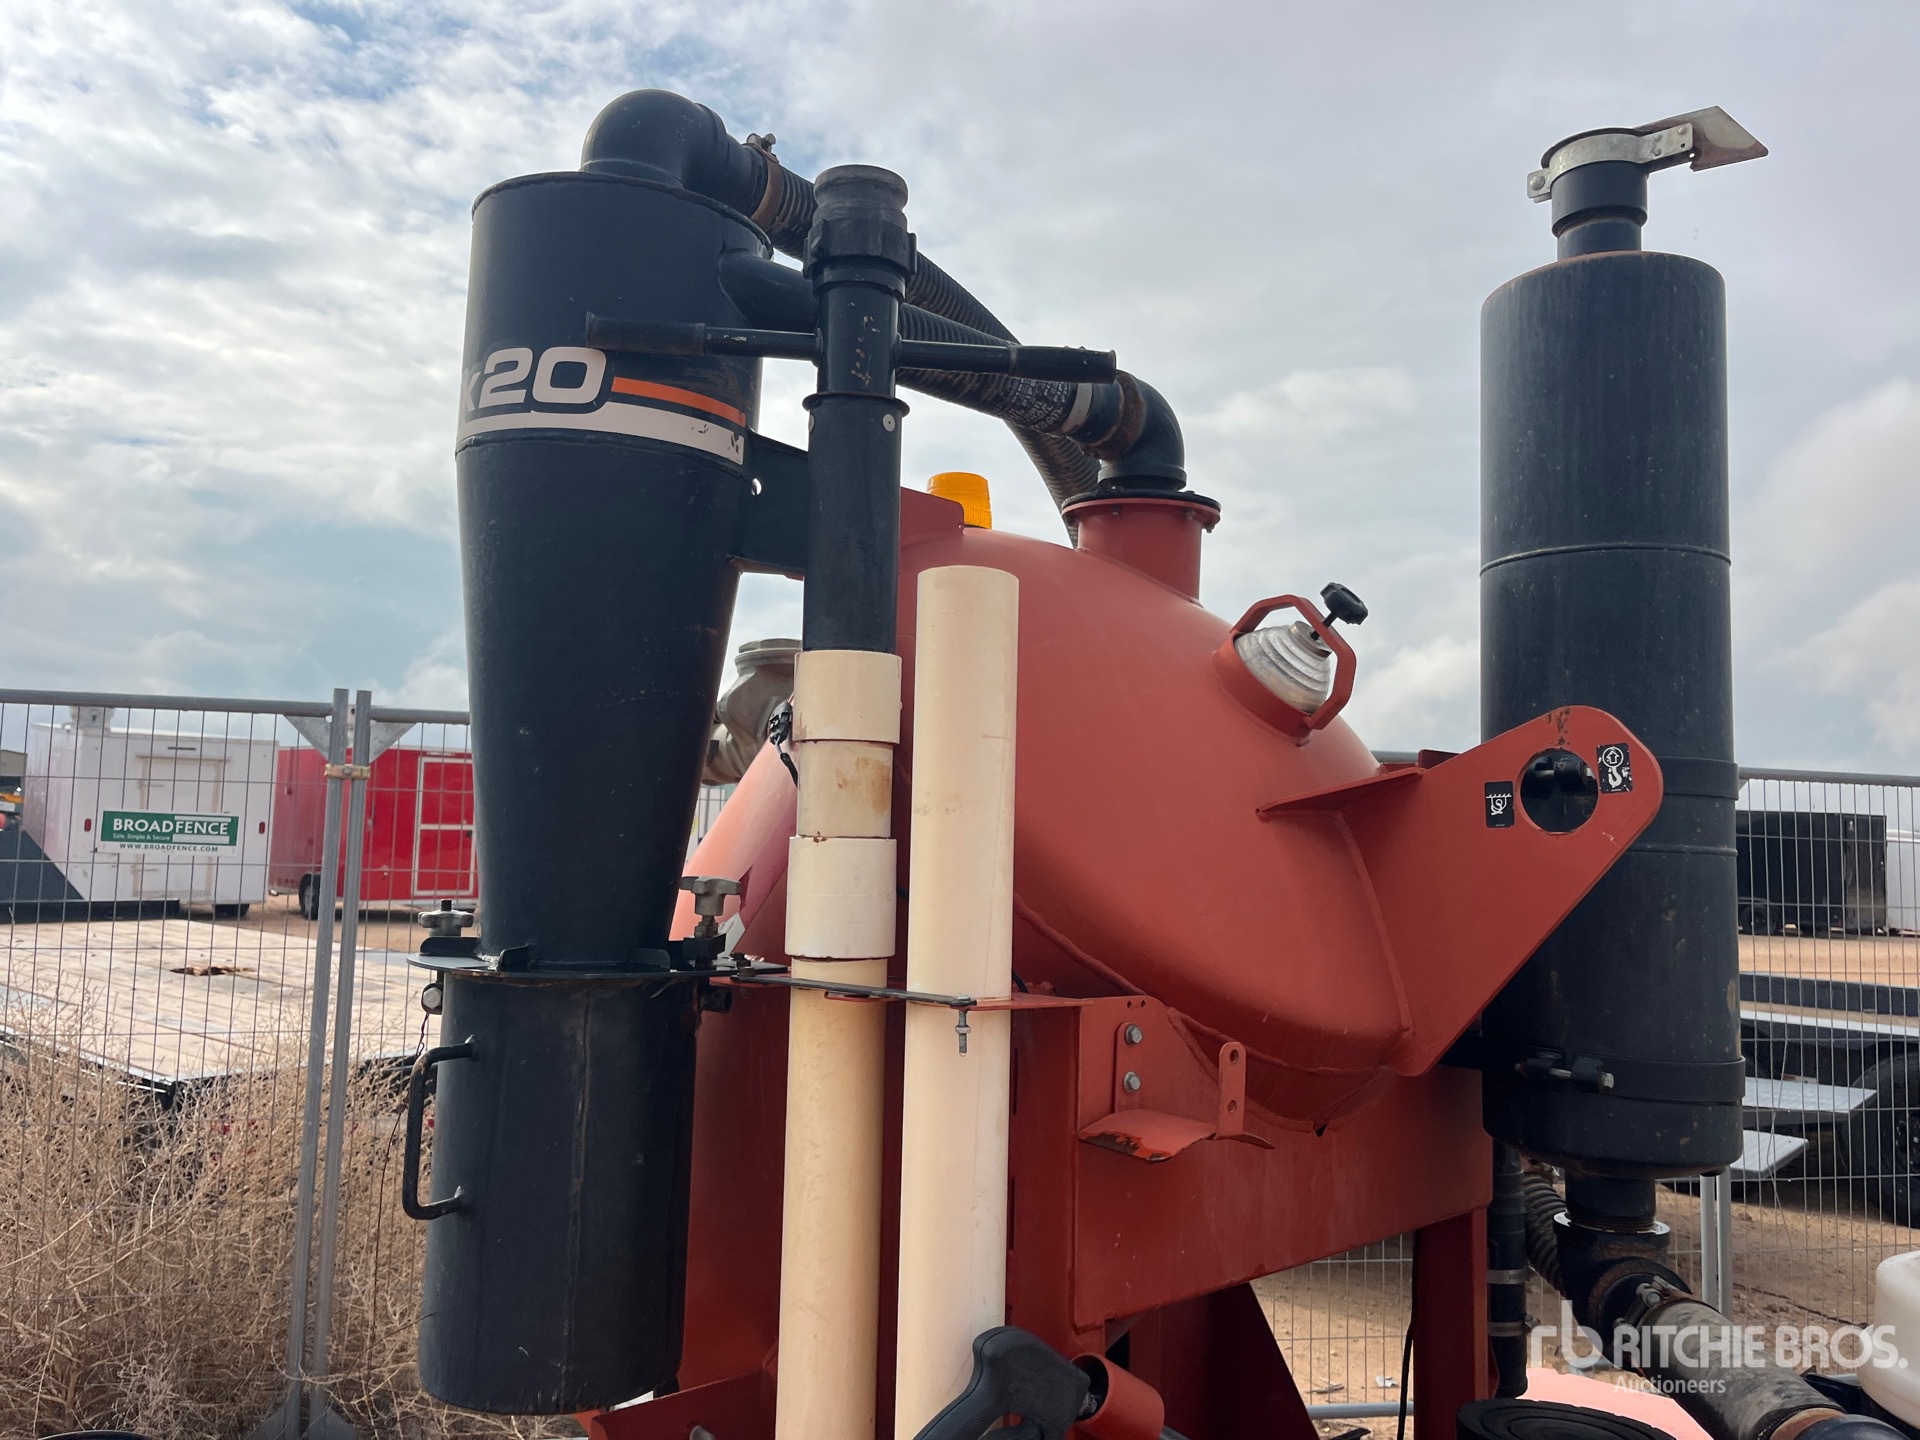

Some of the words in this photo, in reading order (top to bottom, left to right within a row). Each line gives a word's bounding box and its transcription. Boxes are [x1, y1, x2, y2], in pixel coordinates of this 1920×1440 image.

[113, 818, 229, 835] BROADFENCE
[127, 833, 145, 841] Simple
[120, 843, 218, 852] WWW.BROADFENCE.COM
